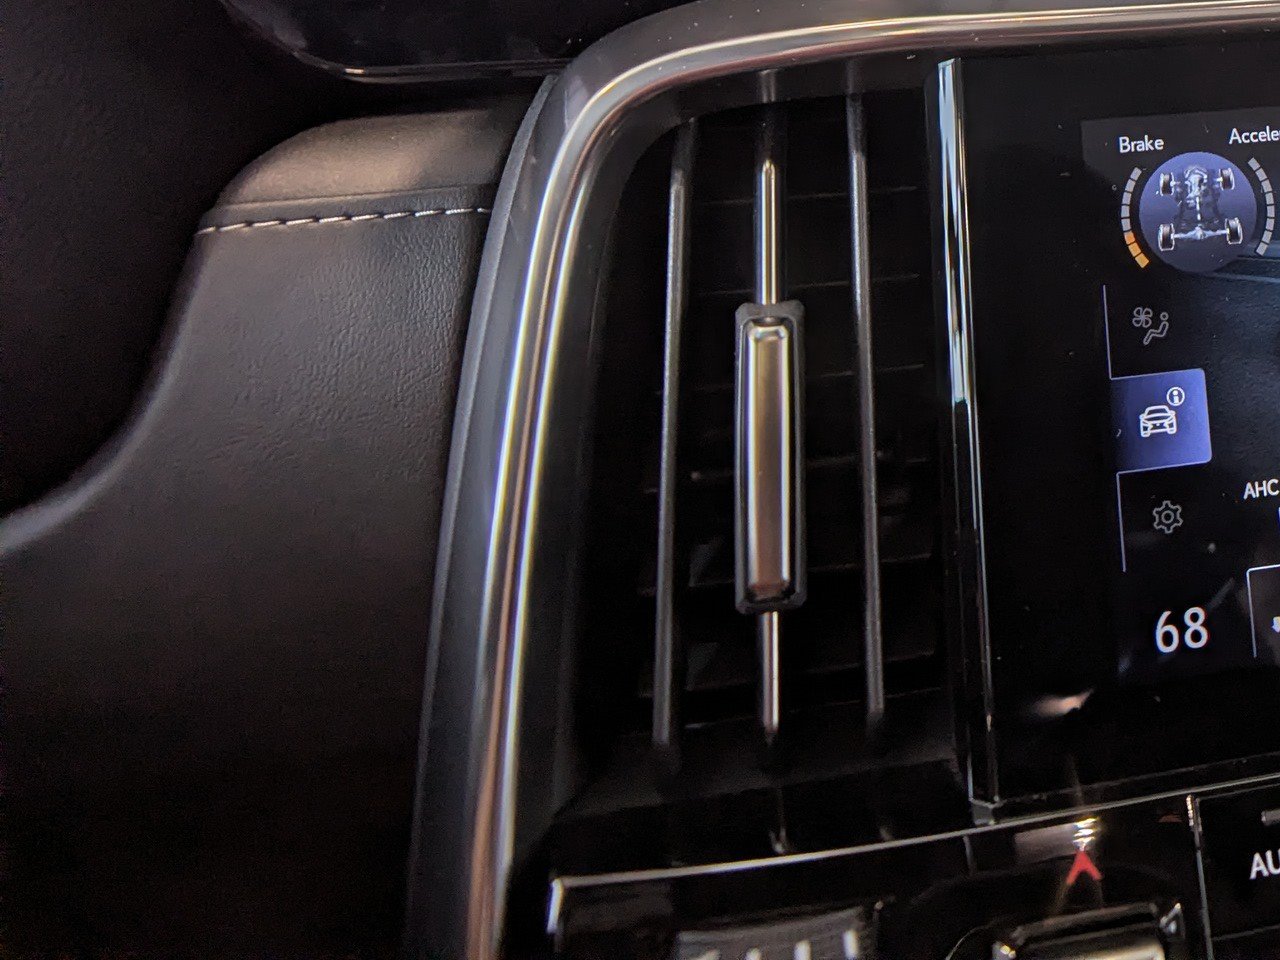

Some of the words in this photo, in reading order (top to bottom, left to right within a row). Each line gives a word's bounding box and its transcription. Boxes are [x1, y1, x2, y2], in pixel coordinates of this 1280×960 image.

[1118, 136, 1165, 154] Brake
[1243, 477, 1280, 500] AHC
[1155, 606, 1210, 654] 68
